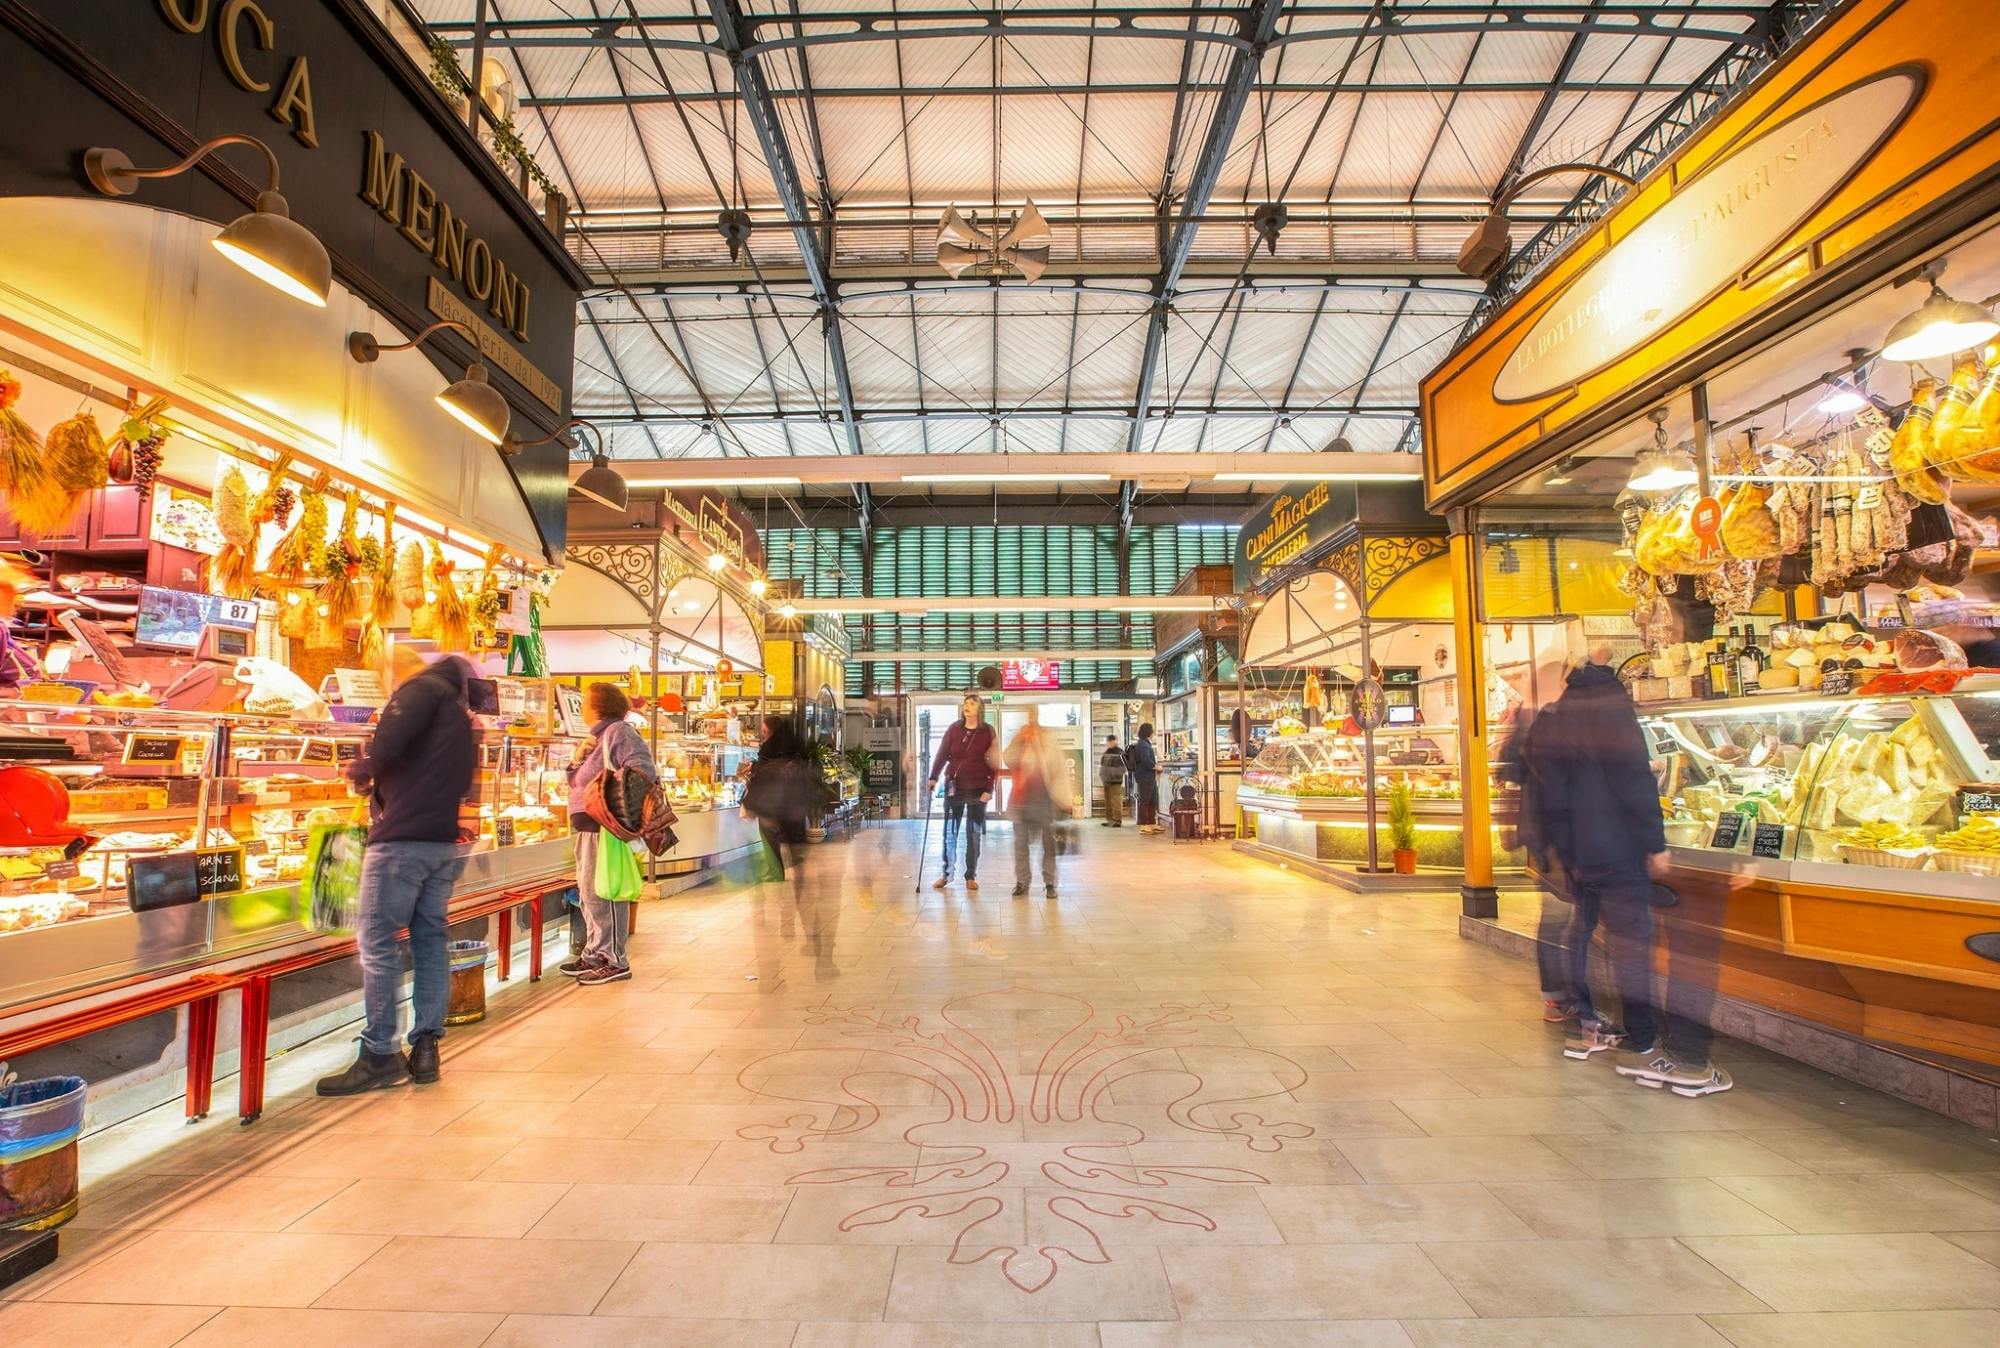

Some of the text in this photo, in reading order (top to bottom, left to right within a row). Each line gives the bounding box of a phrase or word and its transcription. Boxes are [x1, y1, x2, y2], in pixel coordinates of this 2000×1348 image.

[363, 129, 530, 343] MENONI
[434, 286, 509, 366] Macelleria
[1247, 479, 1329, 561] CARNI MAGICHE
[230, 604, 249, 620] 87
[198, 855, 233, 867] ARNE
[200, 872, 240, 885] SCANA
[1649, 1056, 1676, 1076] N
